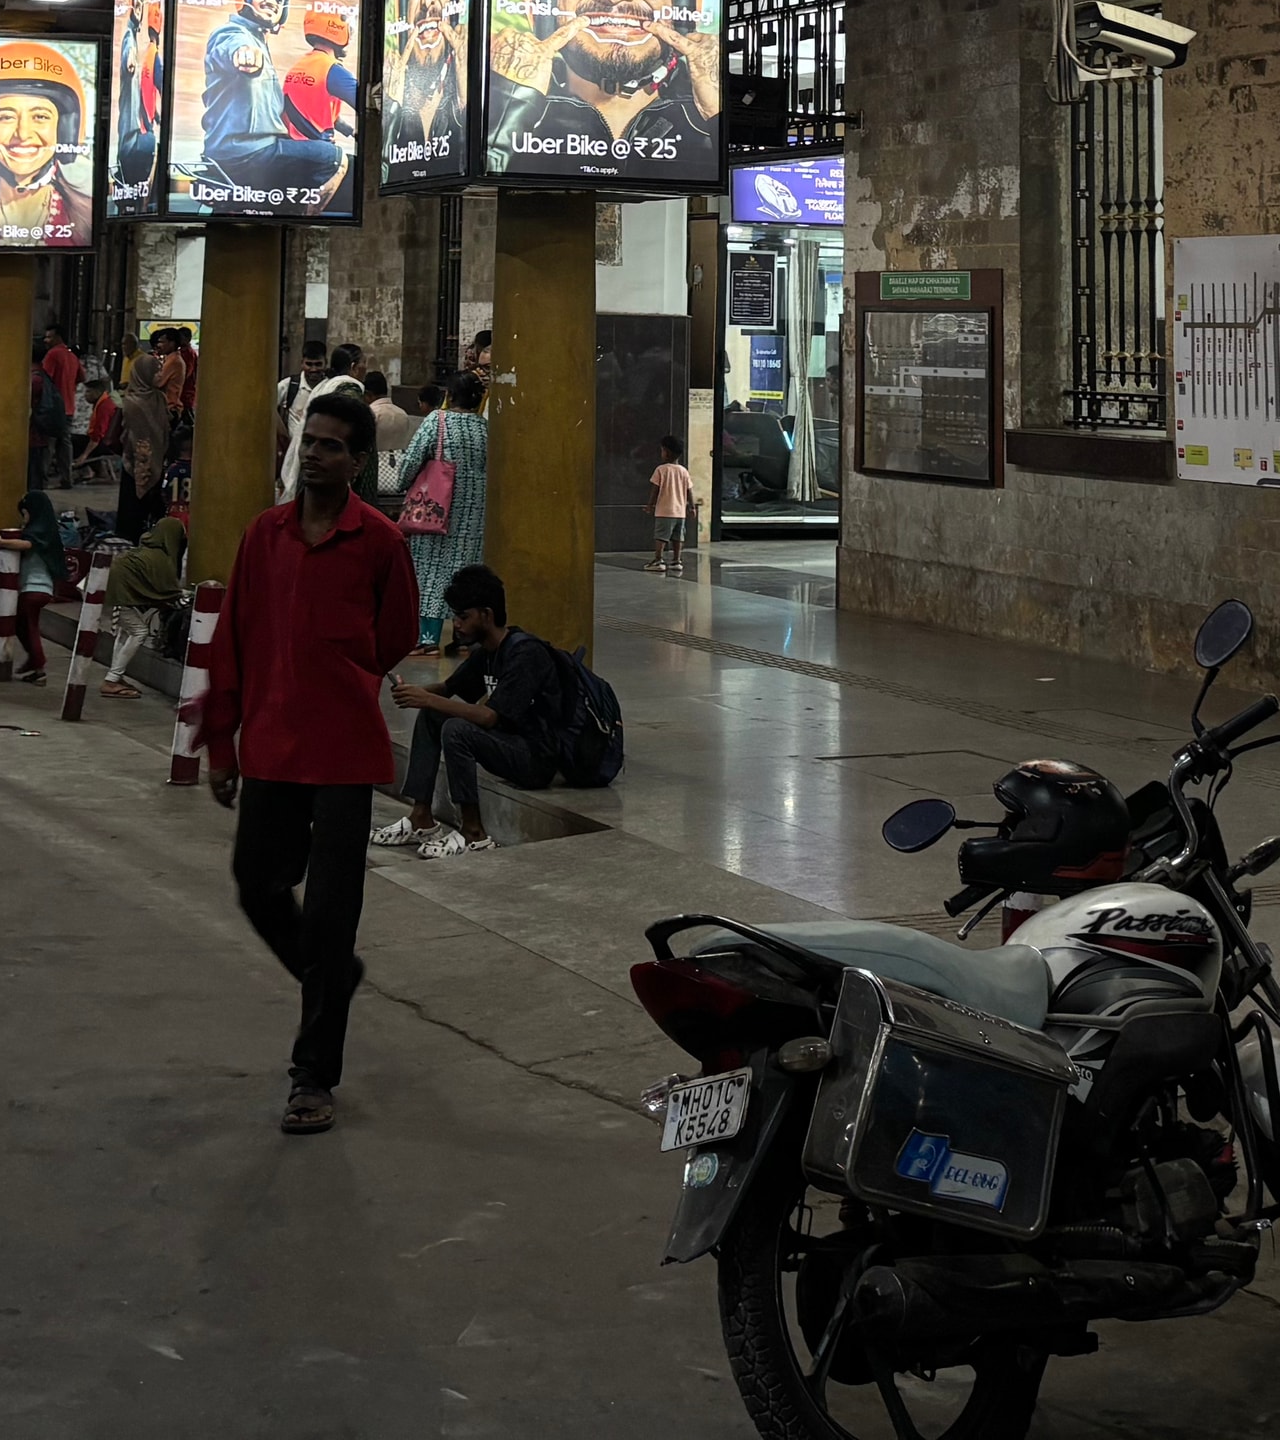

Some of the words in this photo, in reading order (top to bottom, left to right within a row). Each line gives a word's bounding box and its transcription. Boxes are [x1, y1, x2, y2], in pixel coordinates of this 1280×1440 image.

[661, 5, 714, 24] Dikhegi
[33, 56, 63, 76] Bike
[389, 143, 408, 164] Uber
[511, 131, 564, 155] Uber
[566, 134, 608, 157] Bike
[610, 138, 631, 160] @
[189, 183, 232, 202] Uber
[233, 186, 266, 203] Bike
[268, 189, 284, 205] @
[2, 225, 30, 238] Bike
[1074, 1064, 1094, 1082] ero
[680, 1079, 736, 1118] MH01C
[673, 1107, 732, 1147] K5548
